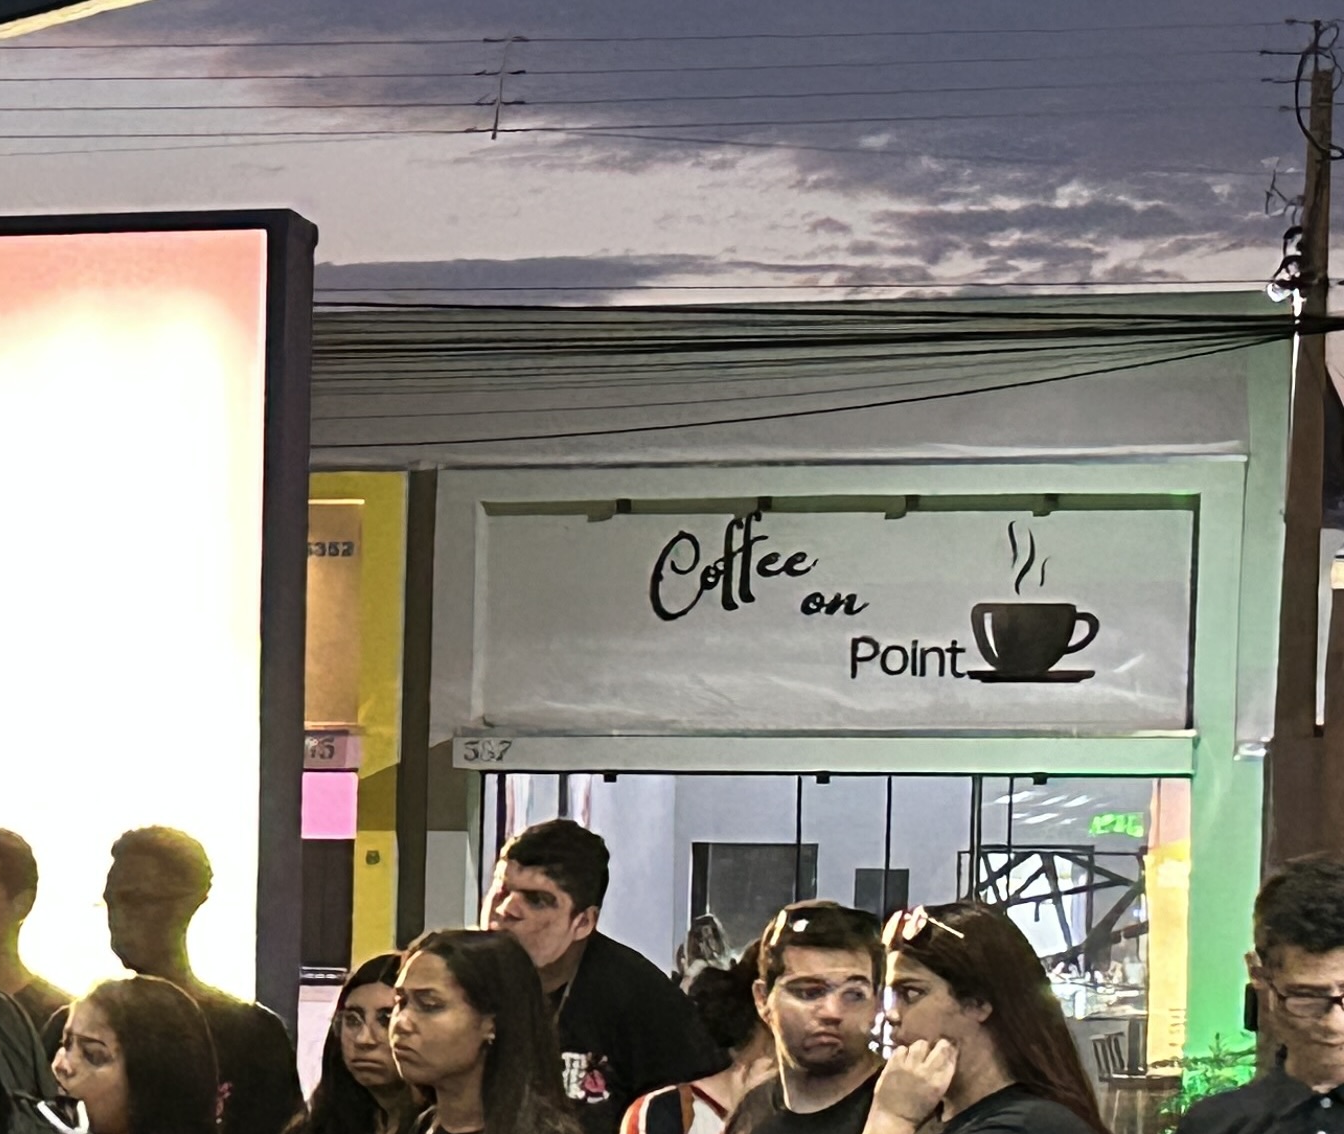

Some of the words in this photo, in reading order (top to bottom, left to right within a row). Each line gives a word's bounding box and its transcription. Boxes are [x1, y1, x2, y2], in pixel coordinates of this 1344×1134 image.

[650, 511, 819, 621] Coffee
[800, 590, 869, 616] on
[850, 635, 968, 679] Point
